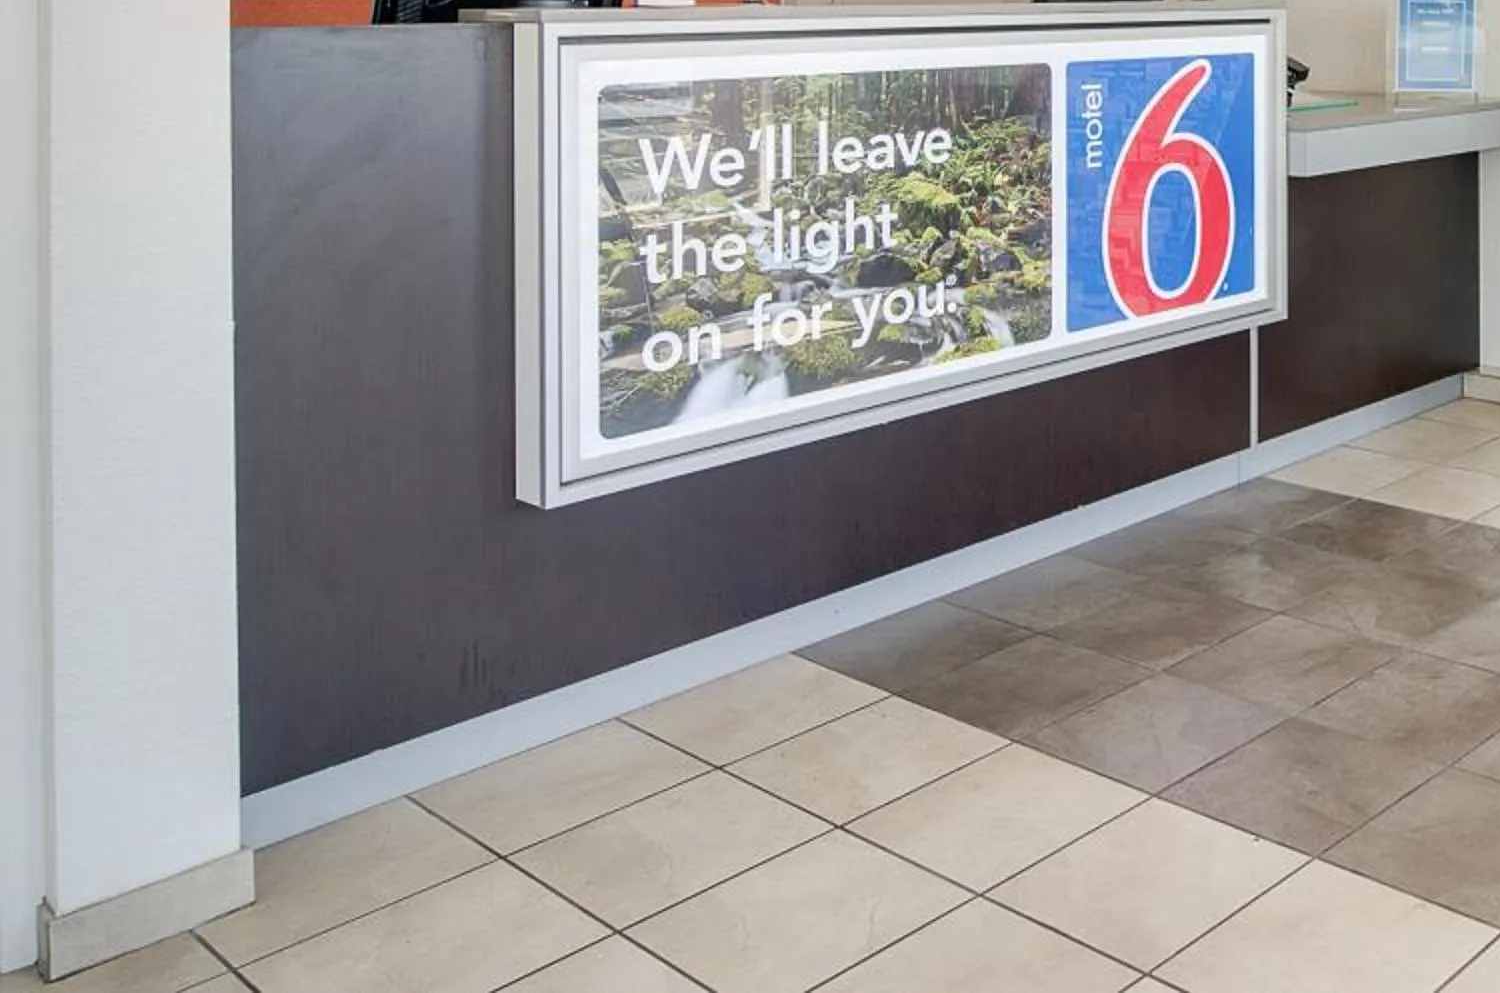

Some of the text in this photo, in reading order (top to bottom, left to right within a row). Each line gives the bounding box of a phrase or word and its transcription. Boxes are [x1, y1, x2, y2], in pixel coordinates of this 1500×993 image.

[638, 120, 953, 197] We'll leave
[1081, 82, 1103, 169] motel
[1102, 58, 1236, 319] 6
[640, 196, 899, 285] the light
[642, 322, 722, 373] on
[750, 291, 832, 352] for
